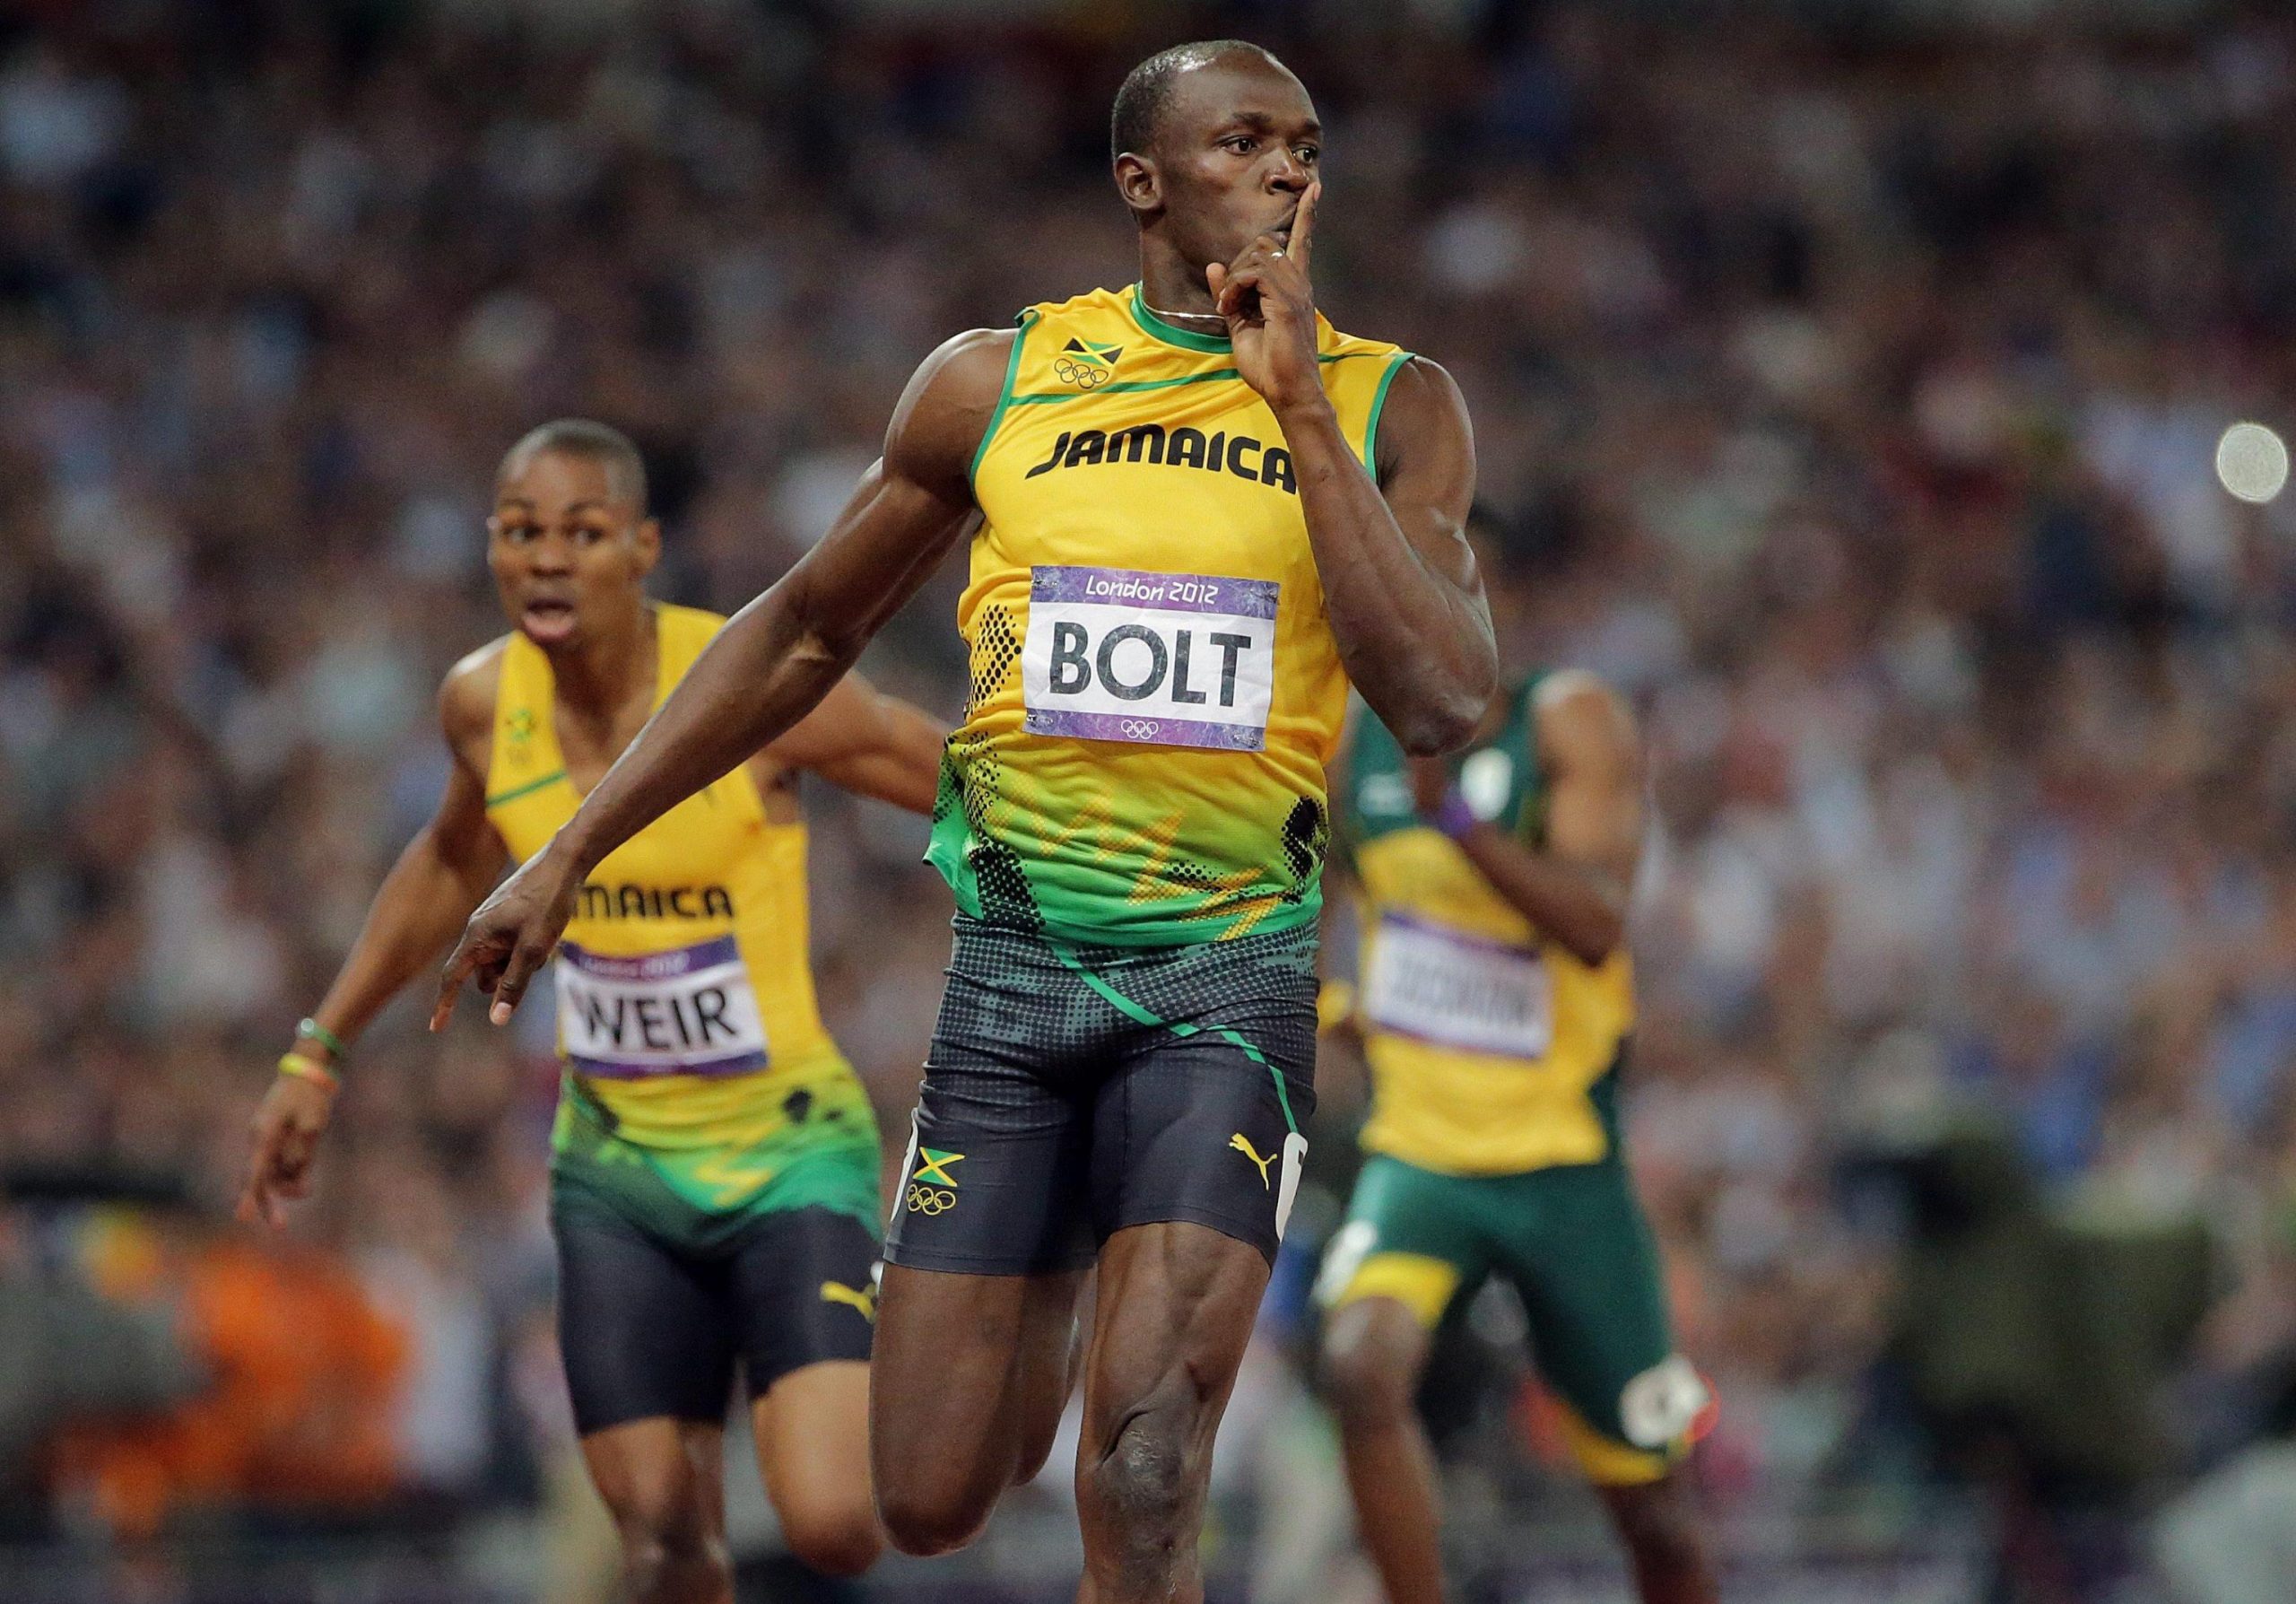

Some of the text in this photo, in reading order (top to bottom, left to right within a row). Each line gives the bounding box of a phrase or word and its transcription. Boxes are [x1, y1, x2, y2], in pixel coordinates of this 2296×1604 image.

[1025, 423, 1297, 495] JAMAICA
[1085, 575, 1219, 605] London 2012
[1048, 621, 1252, 708] BOLT
[574, 882, 734, 919] MAICA
[568, 985, 739, 1050] WEIR
